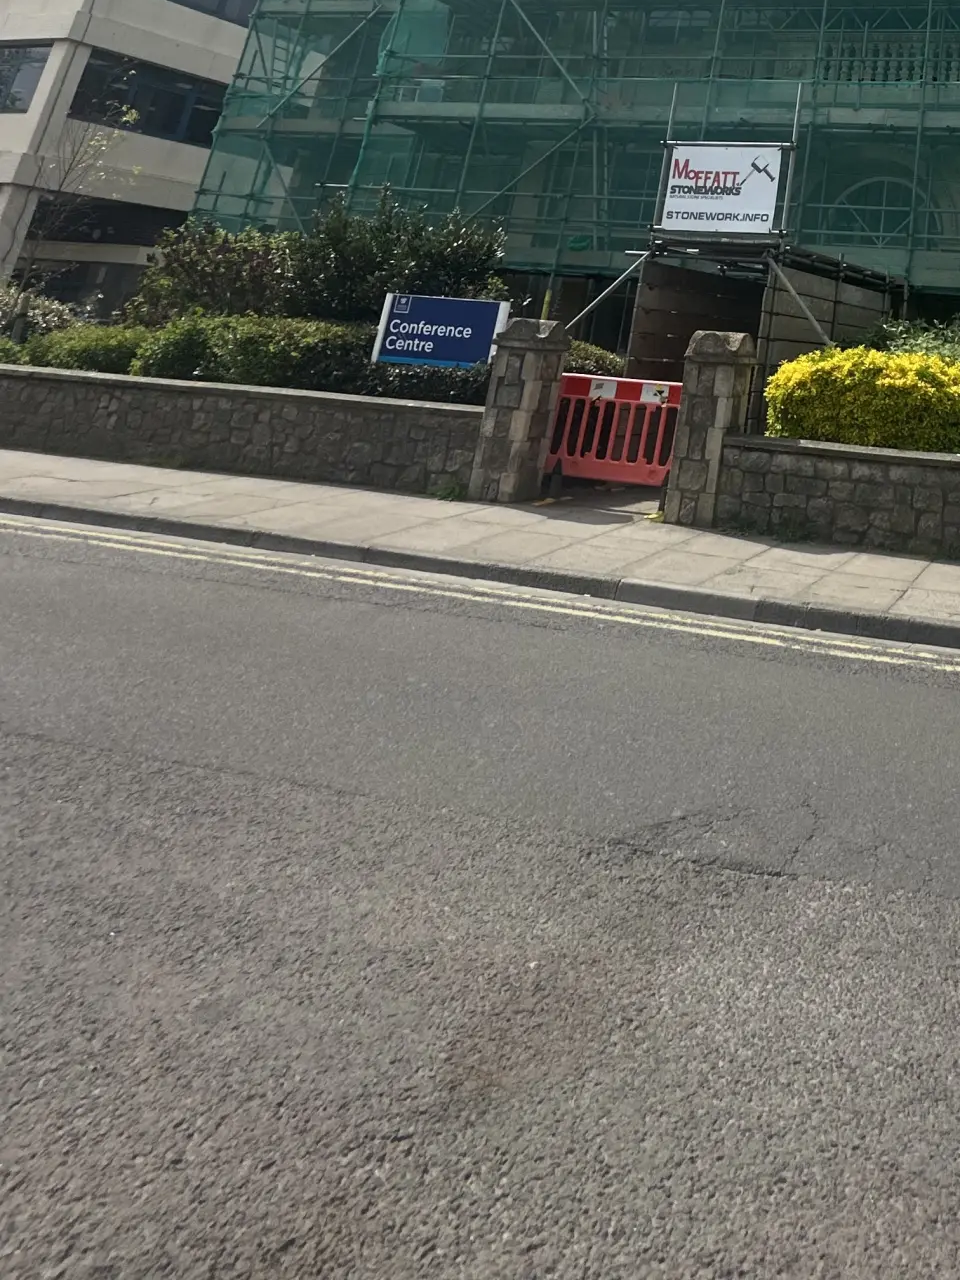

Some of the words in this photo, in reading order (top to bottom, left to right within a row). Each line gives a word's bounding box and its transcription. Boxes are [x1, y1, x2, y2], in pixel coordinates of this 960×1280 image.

[672, 159, 740, 188] MOFFATT
[669, 185, 742, 196] STONEWORKS
[666, 210, 770, 222] STONEWORK.INFO
[389, 319, 472, 338] Conference
[385, 336, 434, 352] Centre
